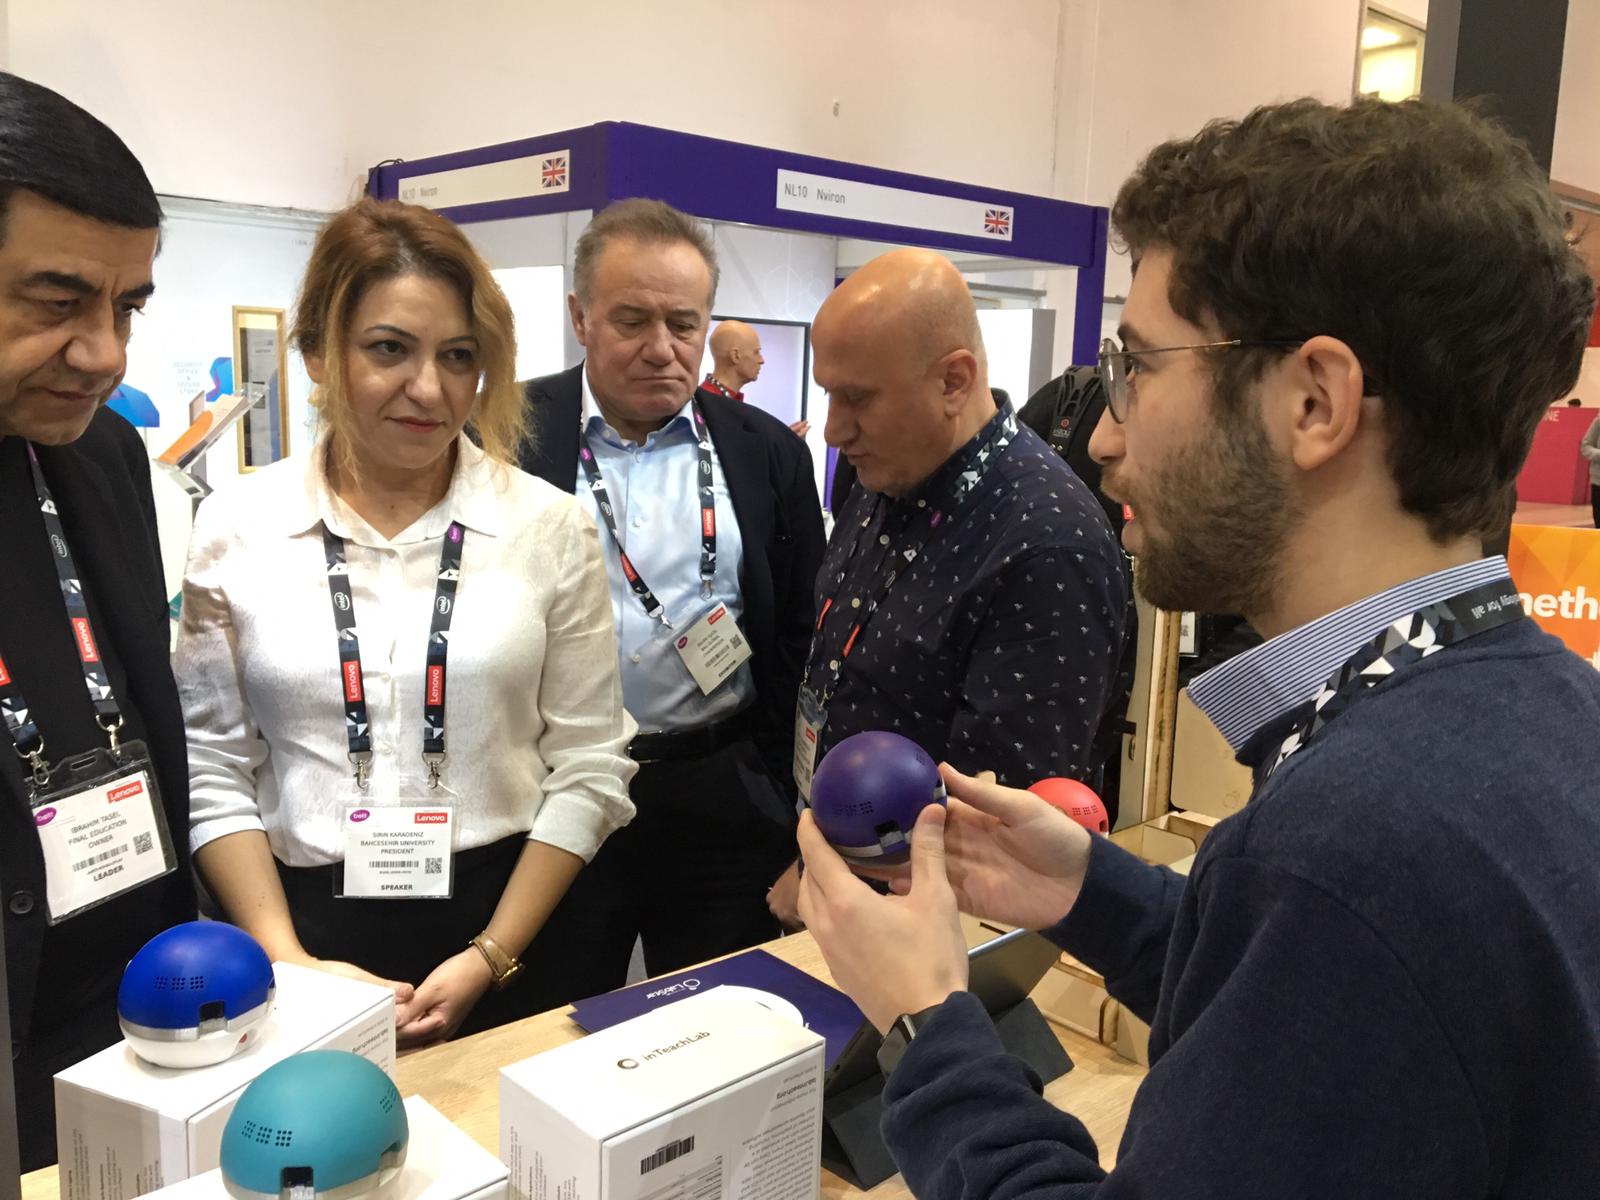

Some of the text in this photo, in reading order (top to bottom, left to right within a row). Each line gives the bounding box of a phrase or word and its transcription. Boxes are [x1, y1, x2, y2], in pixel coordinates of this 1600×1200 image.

[784, 183, 846, 204] NL10 Nviron
[1544, 410, 1560, 422] NE
[1471, 604, 1486, 619] all
[1486, 599, 1502, 612] for
[78, 622, 94, 659] Lenovo
[348, 664, 358, 698] Lenovo
[430, 668, 439, 702] Lenovo
[110, 785, 140, 801] Lenovo
[71, 818, 99, 834] IBRAHIM
[100, 811, 121, 824] TASEL
[416, 814, 445, 822] Lenovo
[68, 834, 88, 846] FINAL
[89, 818, 127, 838] EDUCATION
[88, 834, 113, 849] OWNER
[93, 864, 124, 882] LEADER
